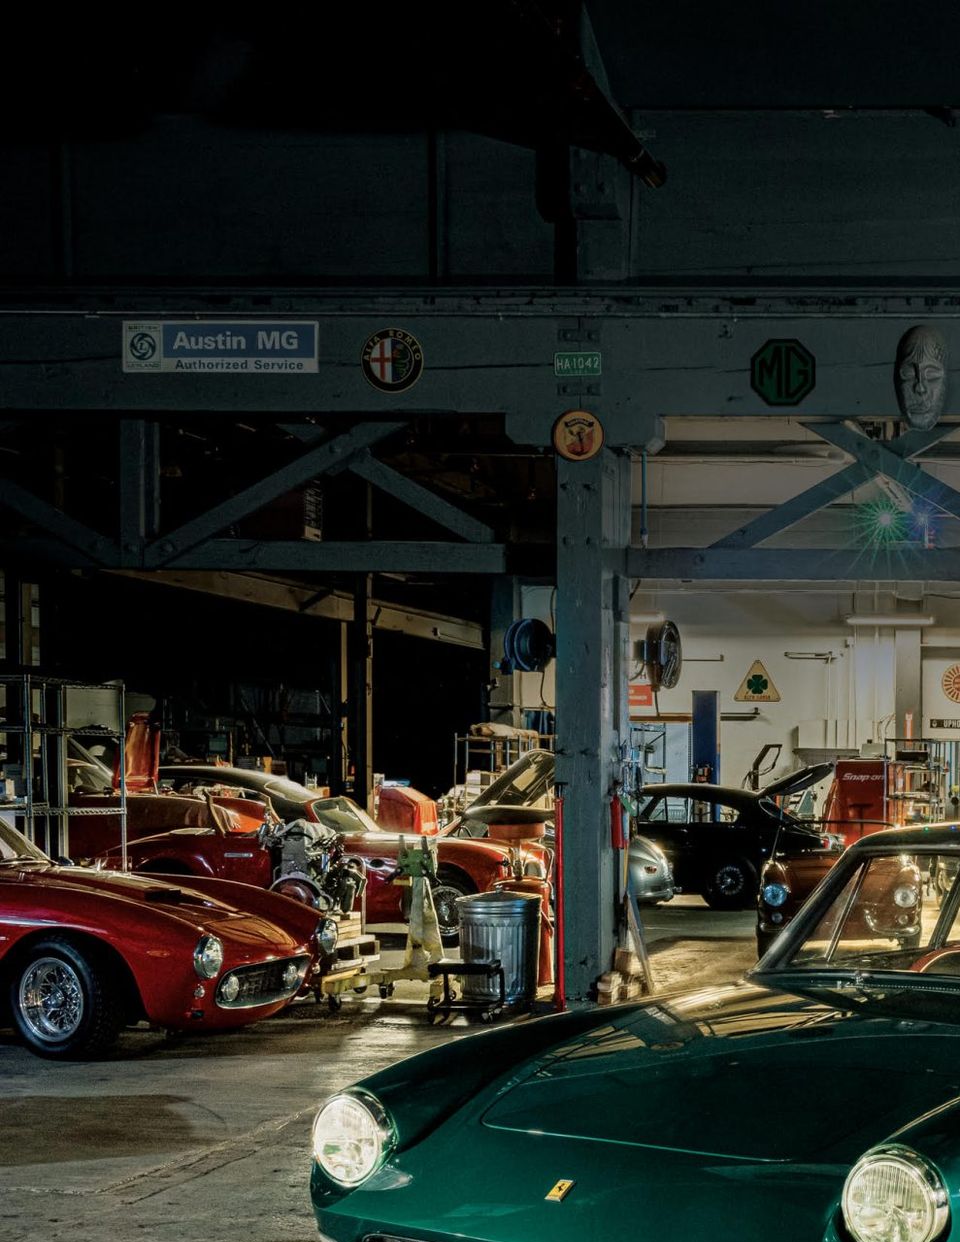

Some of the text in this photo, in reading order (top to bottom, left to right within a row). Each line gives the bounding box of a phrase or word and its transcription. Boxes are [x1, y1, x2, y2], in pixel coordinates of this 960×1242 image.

[173, 331, 299, 350] Austin MG
[363, 330, 421, 361] ALFA ROMEO
[175, 360, 303, 370] Authorized Service
[557, 357, 600, 372] HA1042
[758, 346, 809, 398] MG
[842, 772, 885, 783] Snap-on
